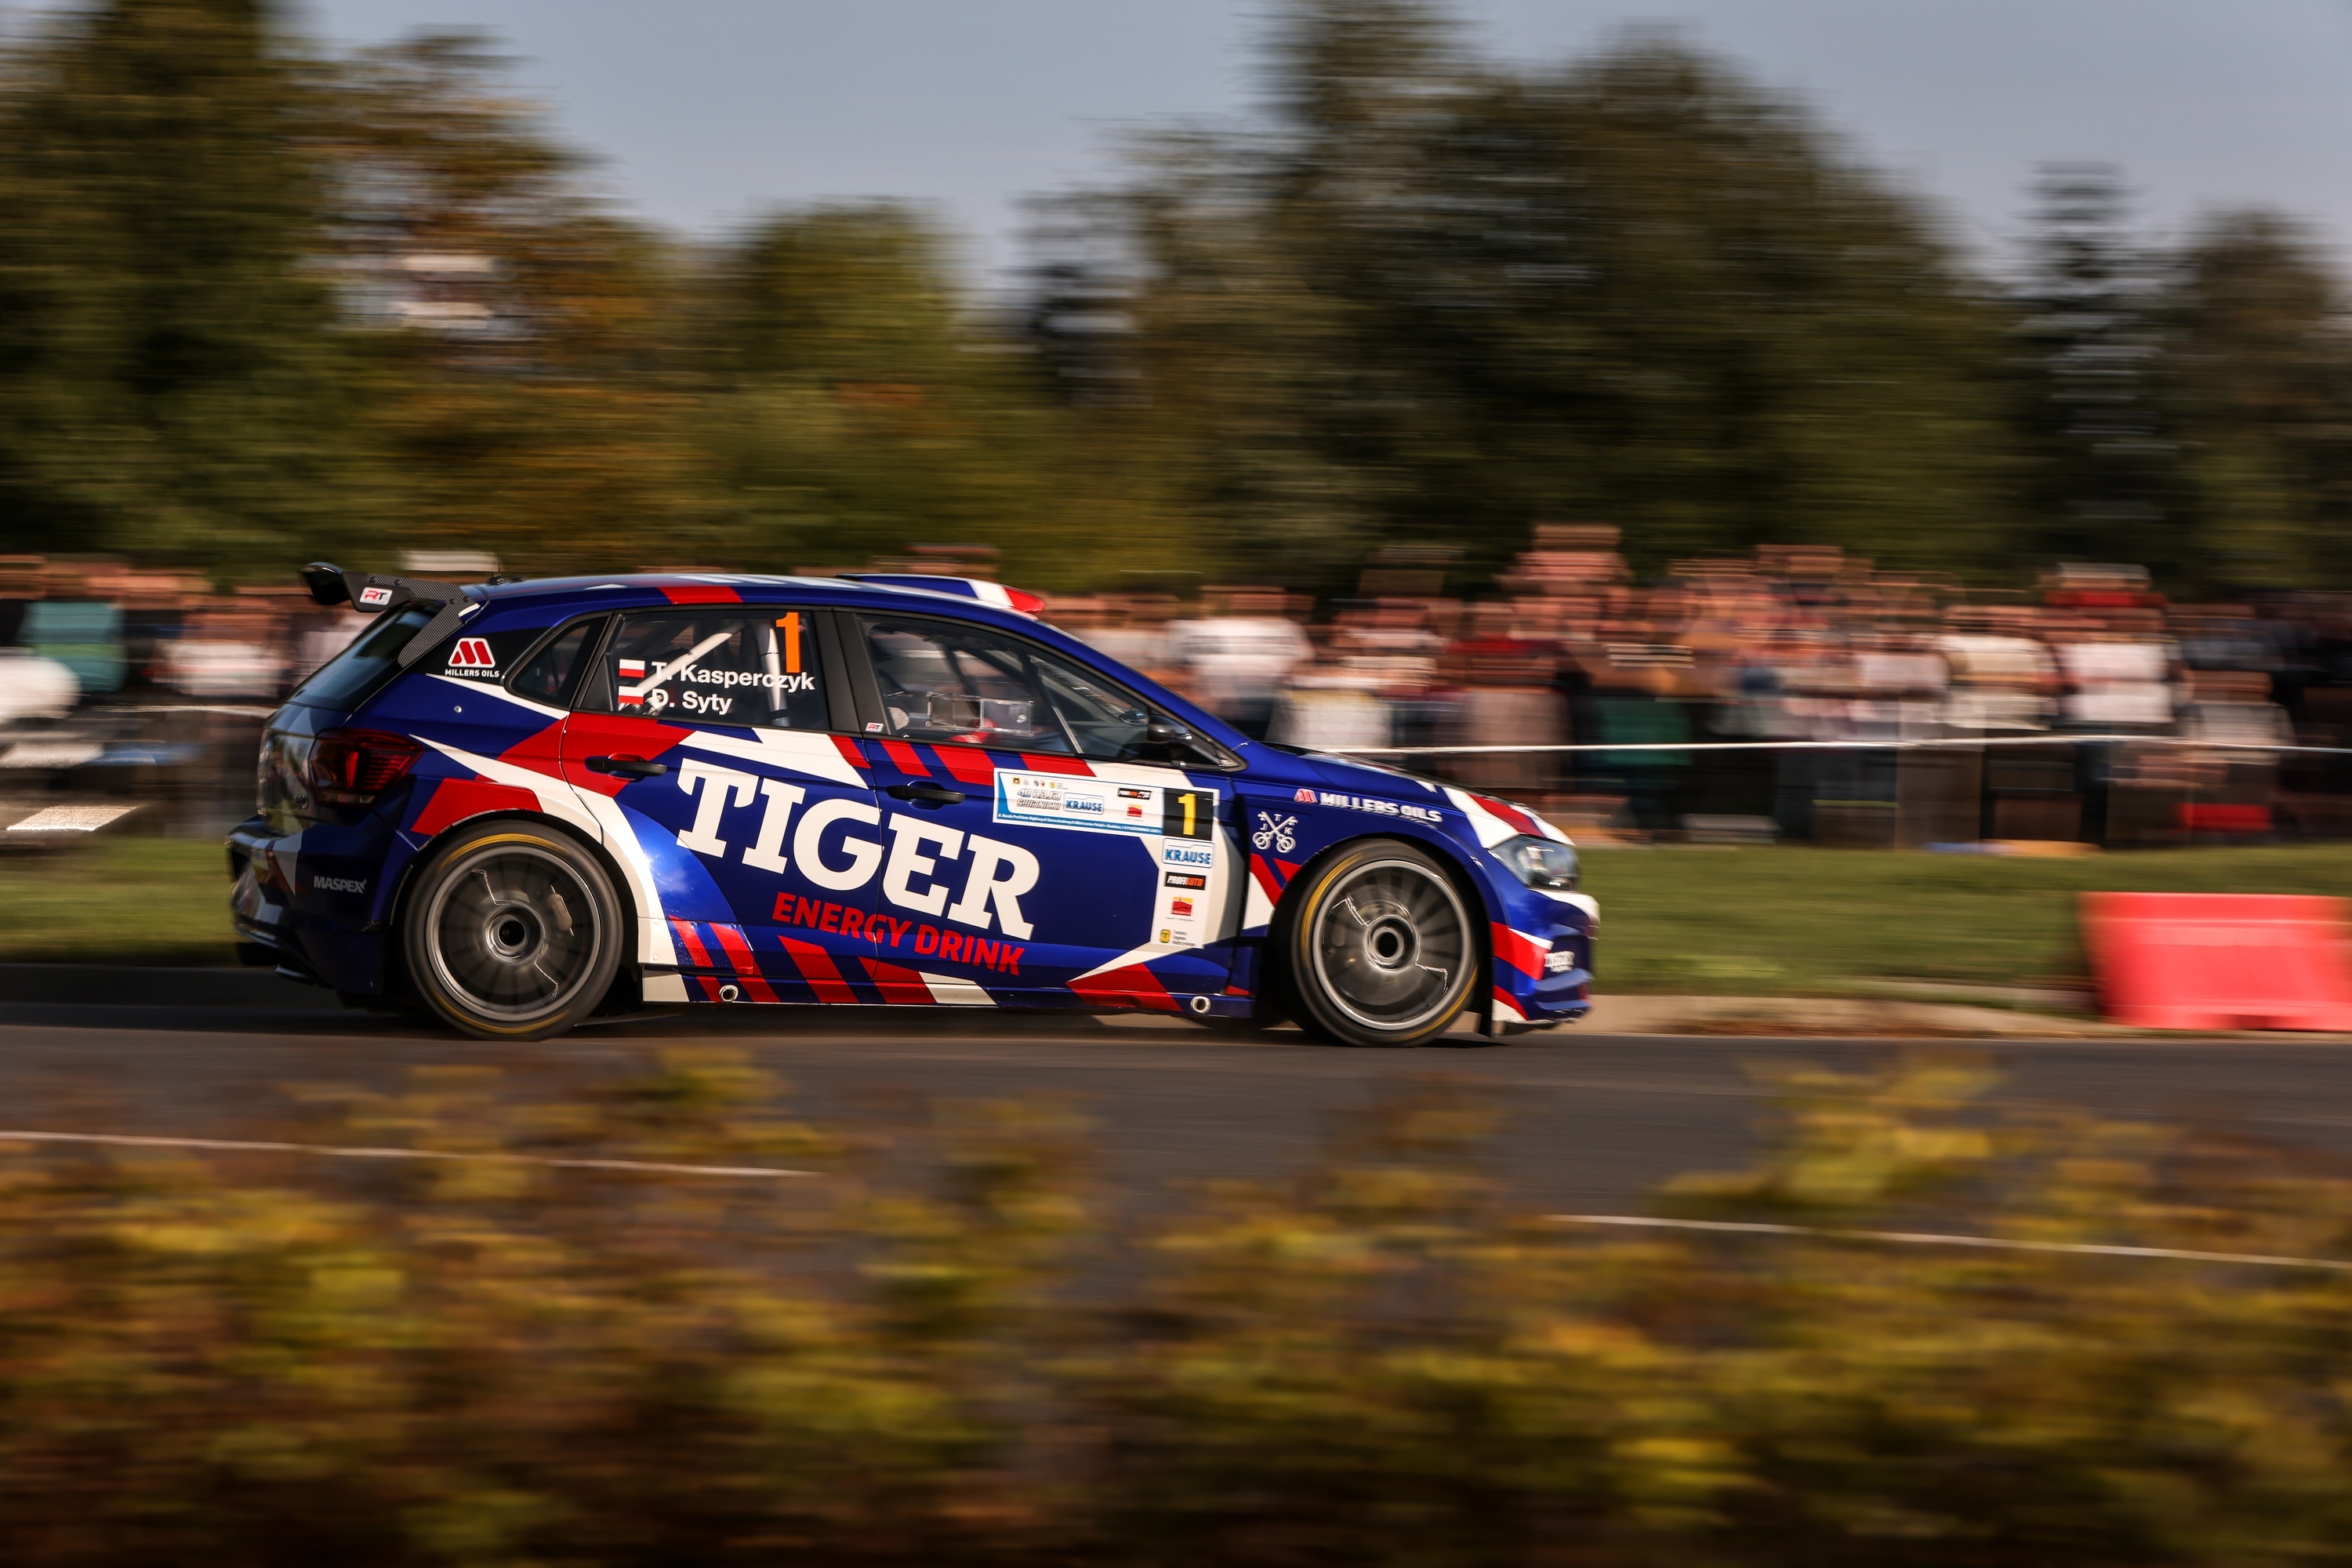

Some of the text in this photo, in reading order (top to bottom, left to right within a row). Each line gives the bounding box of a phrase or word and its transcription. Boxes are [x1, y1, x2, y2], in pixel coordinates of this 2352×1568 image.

[775, 612, 801, 673] 1
[445, 668, 500, 678] MILLERS OILS
[652, 661, 816, 694] T. Kasperczyk
[652, 688, 733, 715] D. Syty
[1065, 800, 1103, 812] KRAUSE
[1178, 793, 1196, 837] 1
[1319, 792, 1443, 823] MILLERS OILS
[676, 757, 1040, 941] TIGER
[1165, 848, 1211, 865] KRAUSE
[314, 875, 368, 895] MASPEX
[771, 891, 1025, 976] ENERGY DRINK
